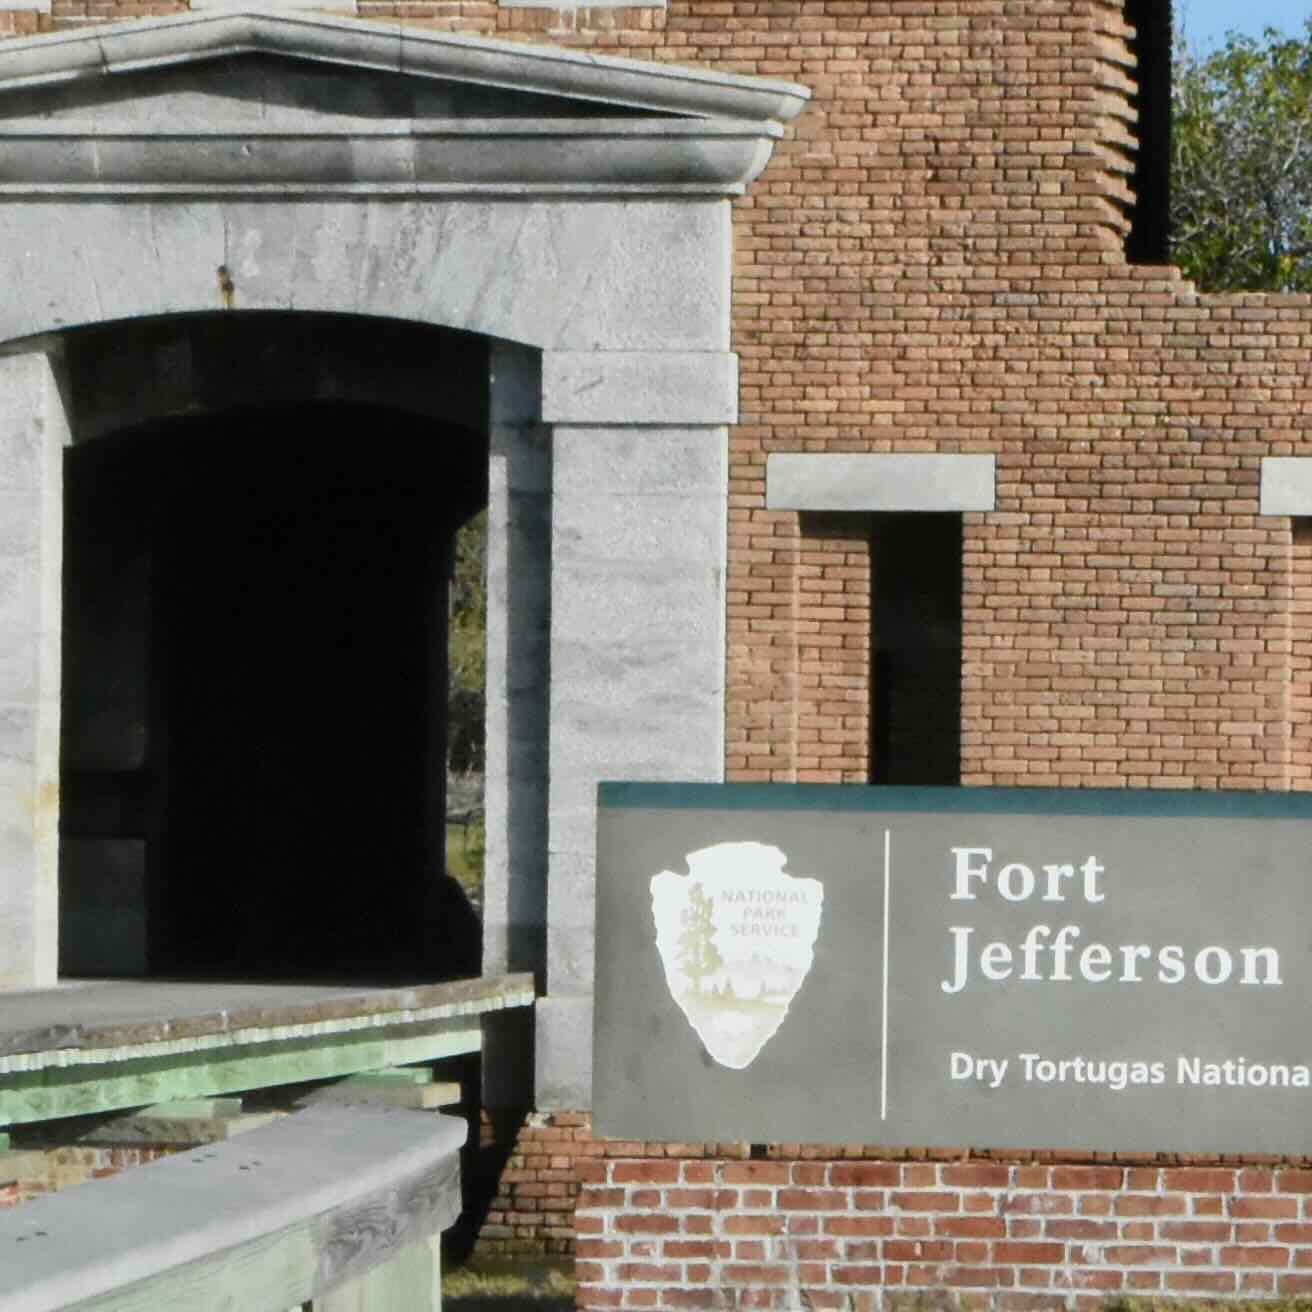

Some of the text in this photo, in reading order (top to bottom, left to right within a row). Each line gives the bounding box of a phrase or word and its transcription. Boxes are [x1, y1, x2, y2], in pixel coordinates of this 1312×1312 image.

[949, 847, 1105, 904] Fort
[721, 888, 809, 905] NATIONAL
[742, 905, 787, 920] PARK
[729, 922, 800, 938] SERVICE
[940, 924, 1284, 994] Jefferson
[950, 1051, 1009, 1089] Dry
[1018, 1052, 1166, 1091] Tortugas
